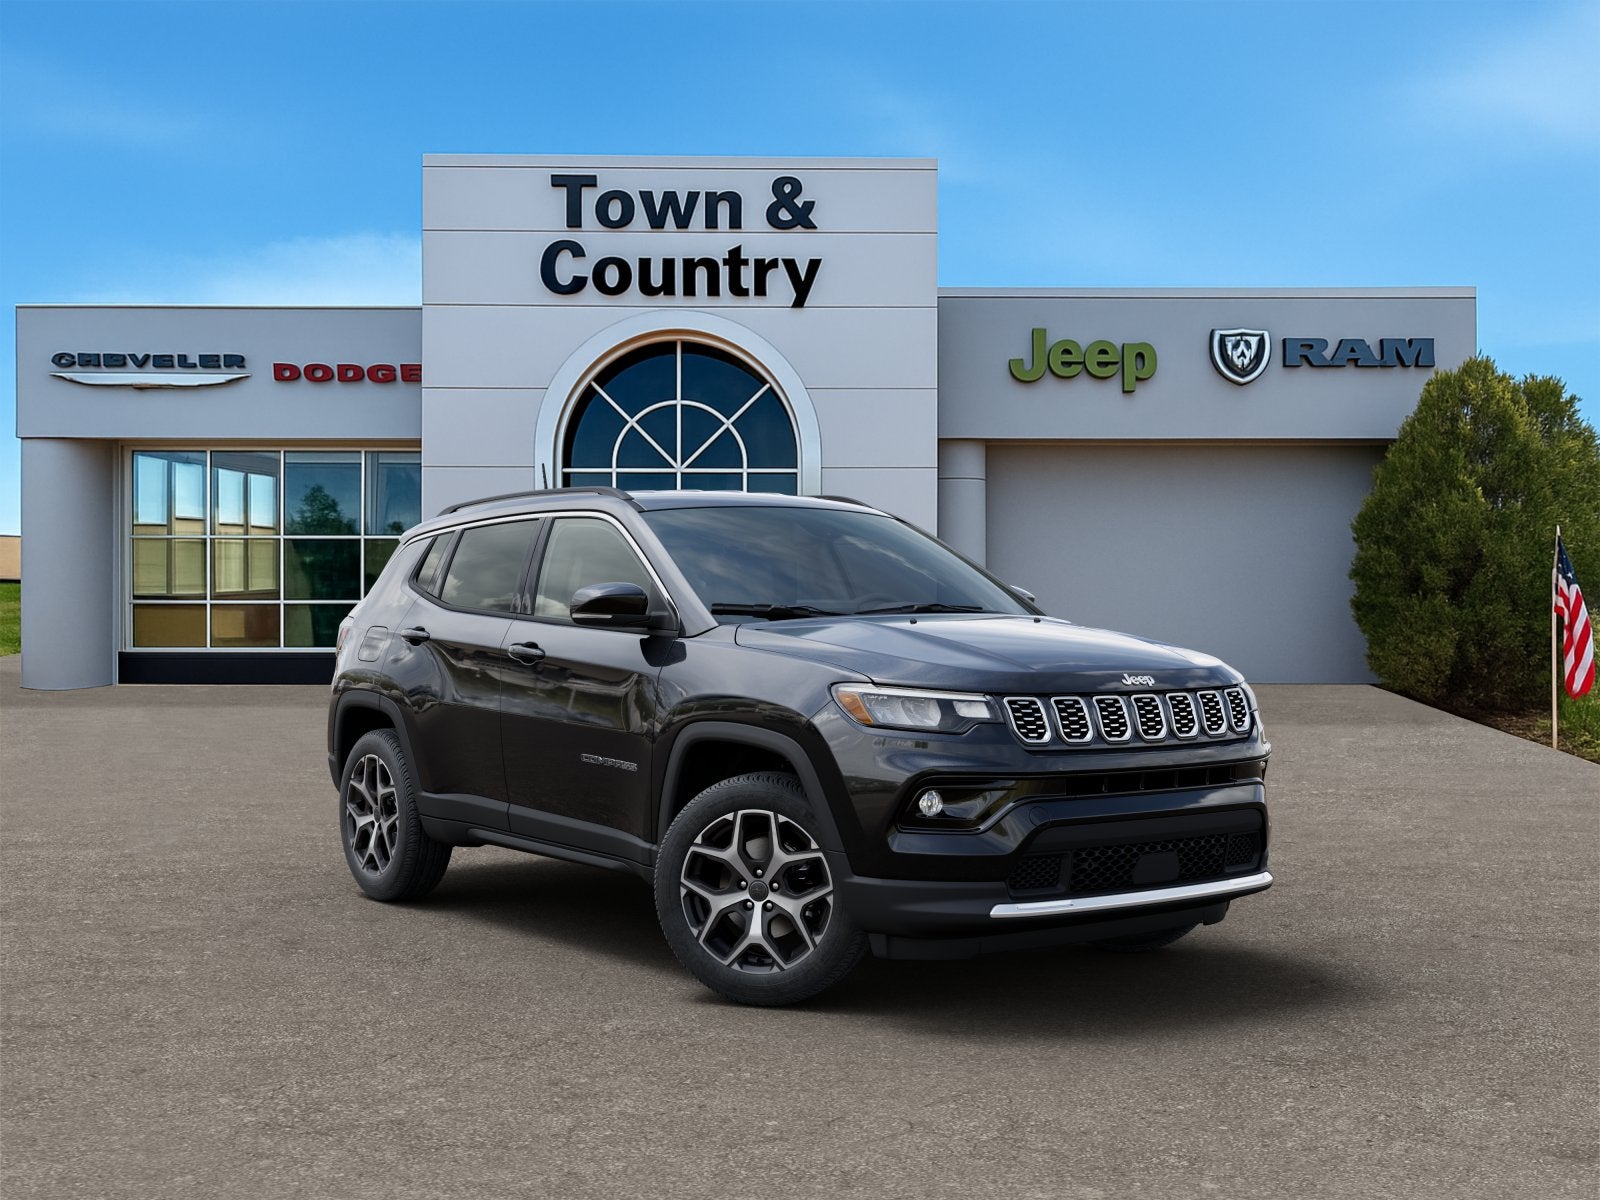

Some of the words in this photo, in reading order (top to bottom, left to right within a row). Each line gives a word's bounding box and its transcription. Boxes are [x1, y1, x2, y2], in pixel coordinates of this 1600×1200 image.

[550, 174, 743, 229] Town
[765, 175, 818, 230] &
[539, 239, 823, 308] Country
[272, 362, 422, 383] DODGE
[1009, 327, 1158, 393] Jeep
[1282, 337, 1436, 368] RAM
[1121, 673, 1156, 687] Jeep
